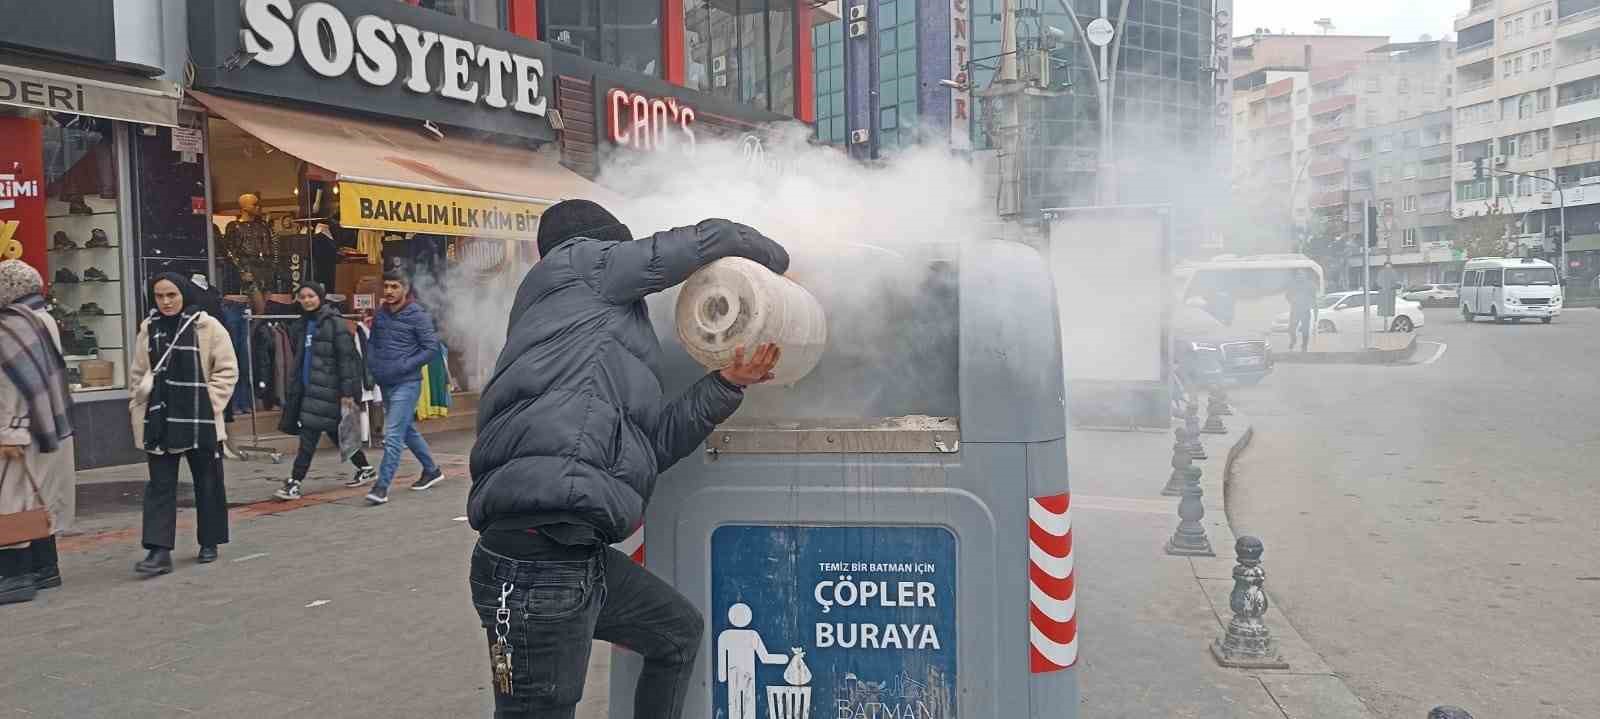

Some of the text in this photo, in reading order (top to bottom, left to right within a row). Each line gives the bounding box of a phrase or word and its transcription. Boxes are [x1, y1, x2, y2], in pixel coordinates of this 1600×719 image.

[239, 0, 547, 117] SOSYETE
[360, 197, 449, 226] BAKALIM
[452, 202, 479, 228] İLK
[482, 205, 513, 231] KİM
[818, 561, 935, 575] TEMİZ BİR BATMAN İÇİN
[814, 574, 936, 613] ÇÖPLER
[815, 622, 940, 649] BURAYA
